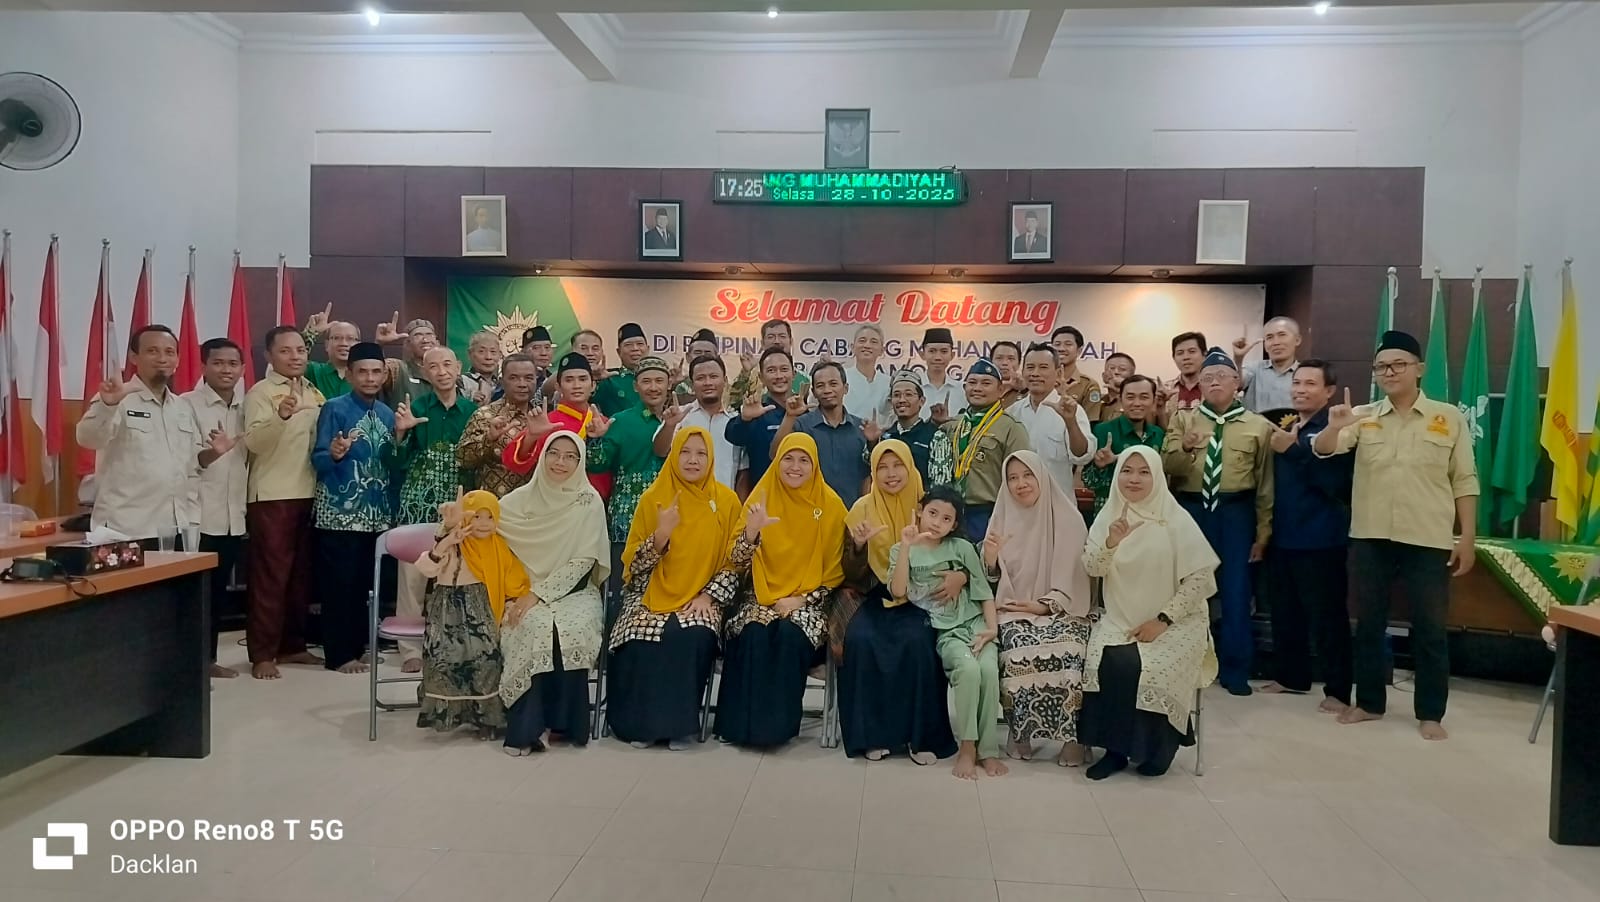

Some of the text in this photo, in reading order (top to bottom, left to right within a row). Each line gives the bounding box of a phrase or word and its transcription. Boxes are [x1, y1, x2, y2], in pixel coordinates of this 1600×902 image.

[719, 178, 763, 197] 17:25
[800, 172, 946, 188] MUHAMMADIYAH
[772, 188, 815, 200] Selasa
[709, 287, 1060, 335] Selamat Datang
[653, 334, 675, 352] DI
